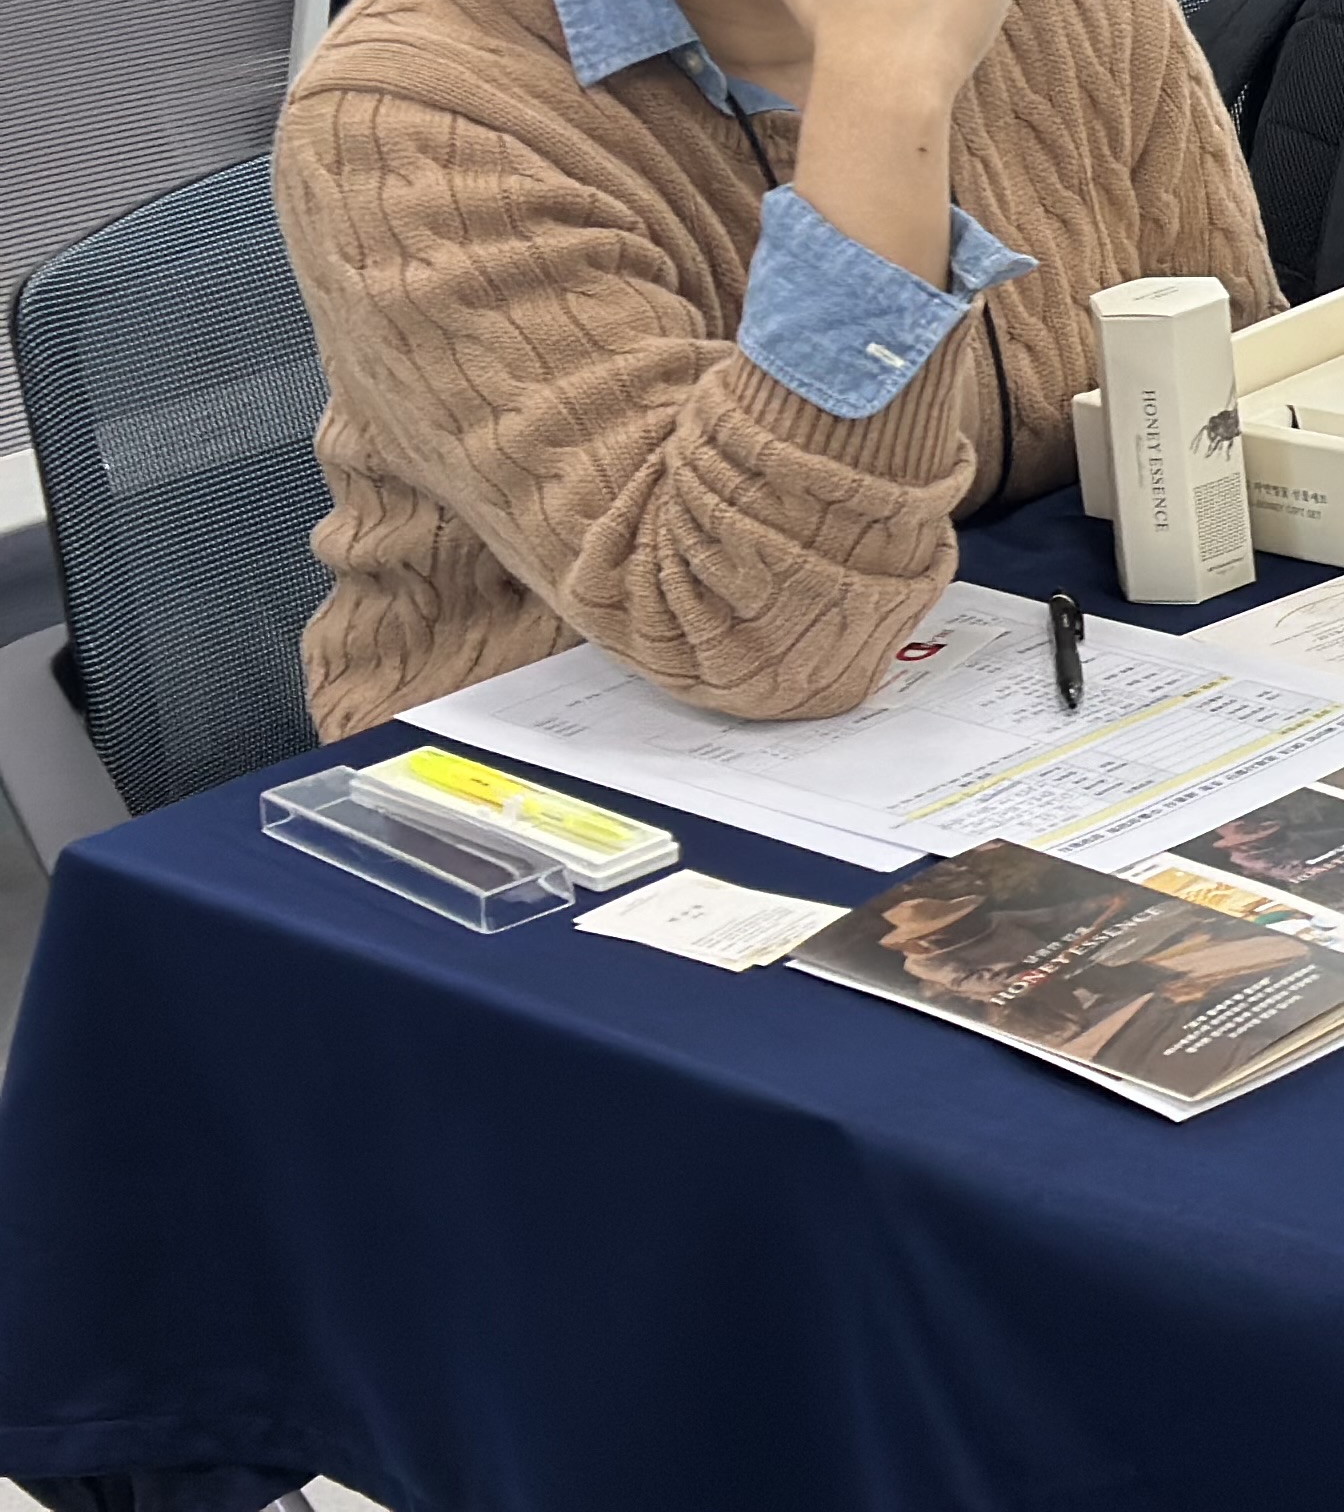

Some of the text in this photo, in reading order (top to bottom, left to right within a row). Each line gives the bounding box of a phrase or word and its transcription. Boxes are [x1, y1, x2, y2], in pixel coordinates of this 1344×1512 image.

[1142, 390, 1169, 532] HONEY ESSENCE
[990, 950, 1070, 1007] HONEY
[1068, 905, 1165, 956] ESSENCE
